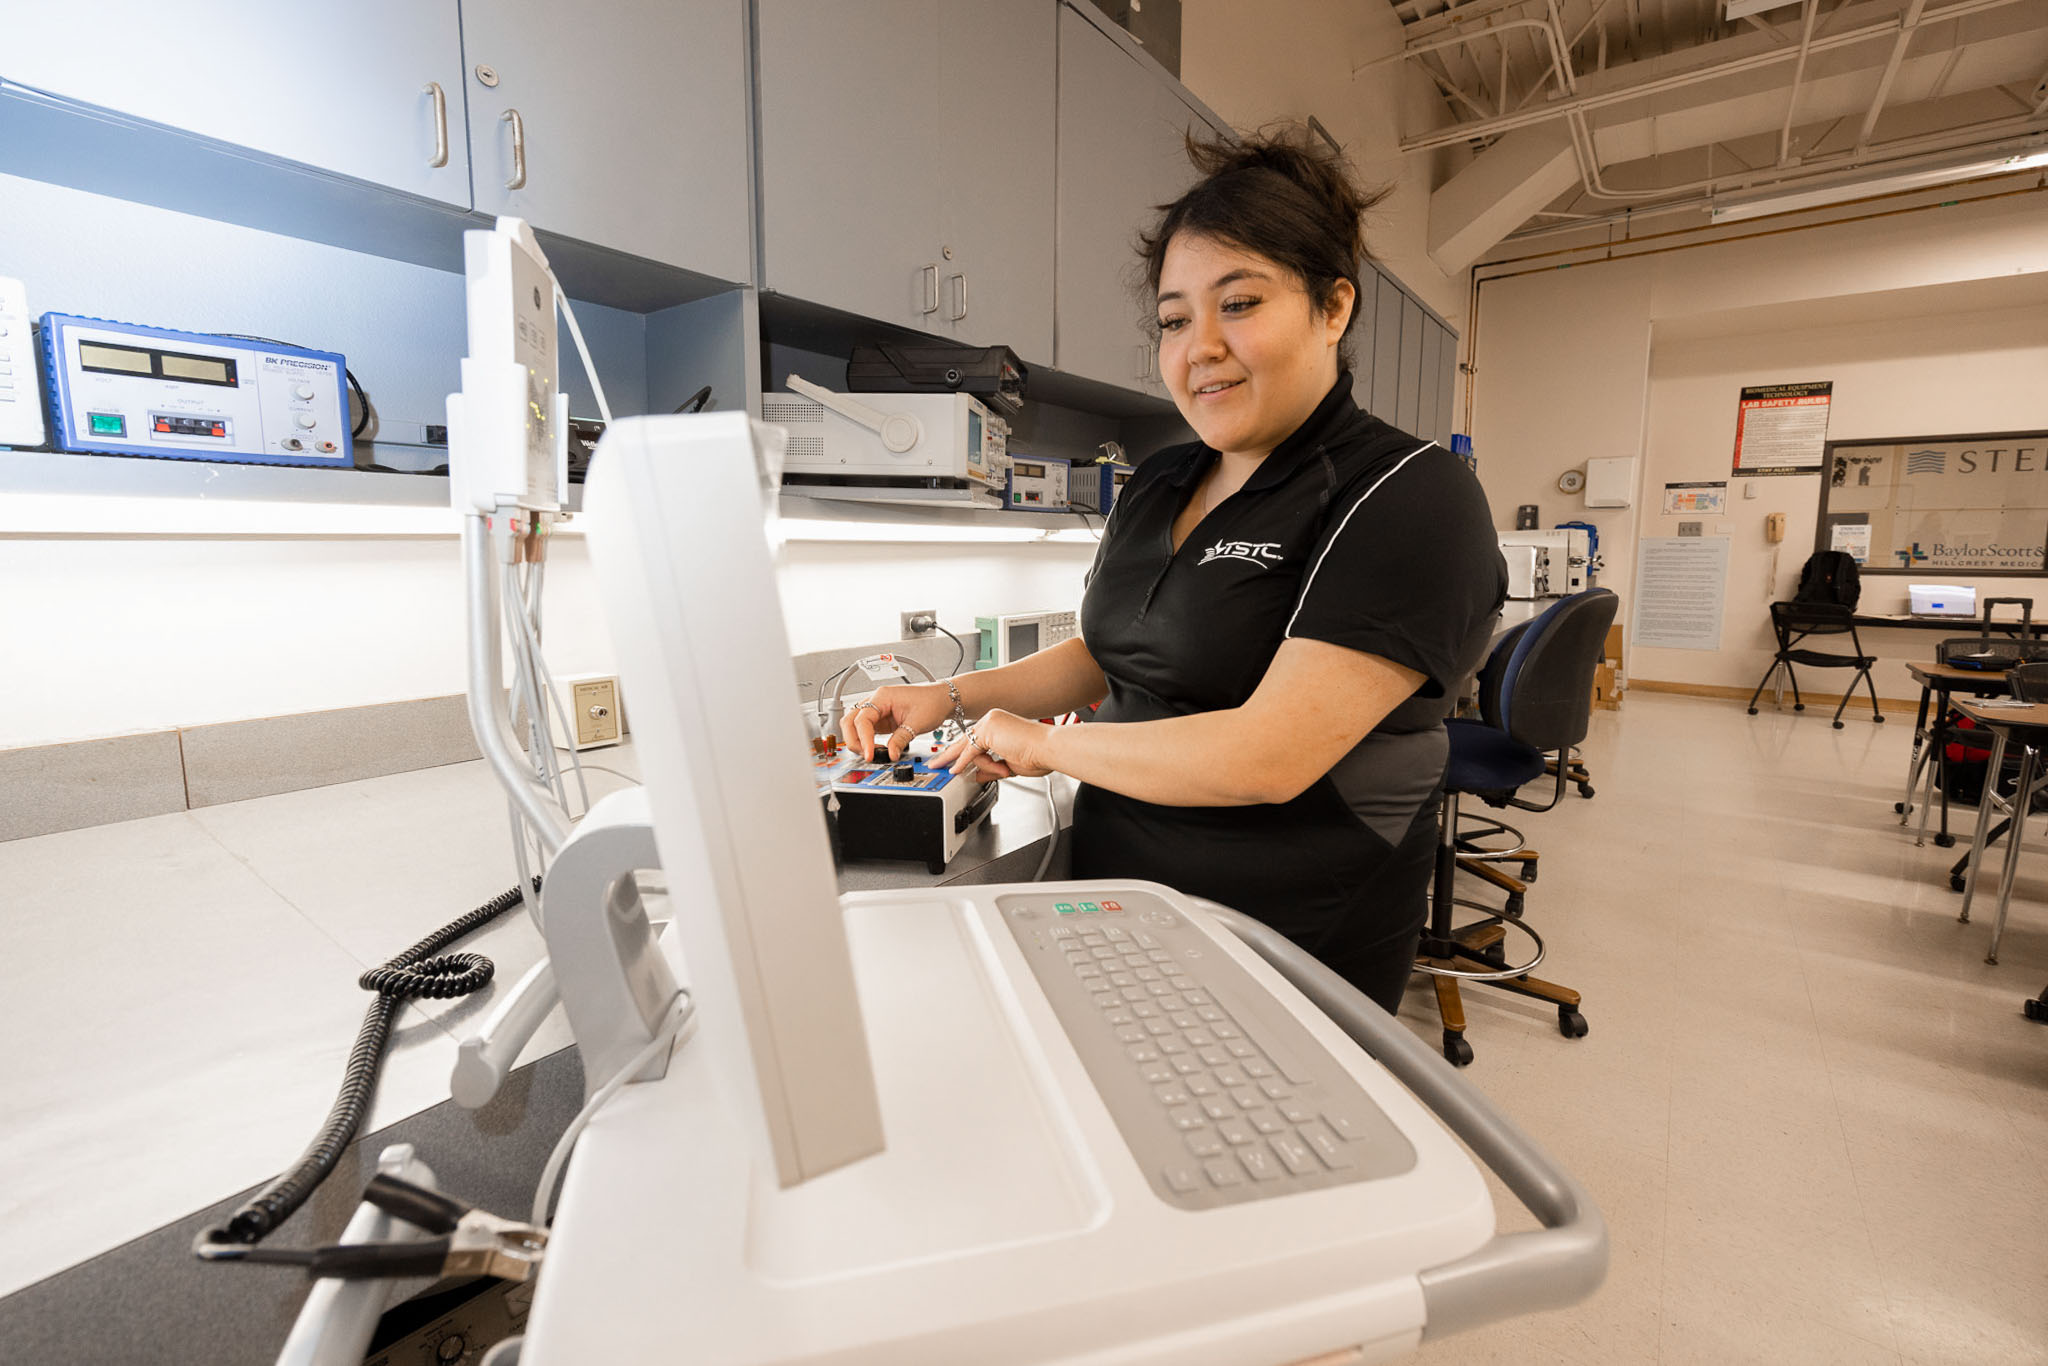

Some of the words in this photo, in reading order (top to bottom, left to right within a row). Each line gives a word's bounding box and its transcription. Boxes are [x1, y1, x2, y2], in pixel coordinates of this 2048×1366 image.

[265, 356, 278, 364] BK
[280, 358, 328, 371] PRECISION
[1746, 386, 1785, 394] BIOMEDICAL
[1787, 383, 1828, 392] EQUIPMENT
[1763, 391, 1808, 399] TECHNOLOGY
[1742, 401, 1760, 409] LAB
[1761, 399, 1795, 408] SAFETY
[1797, 397, 1828, 405] RULES
[1957, 447, 2048, 474] STE
[1223, 541, 1283, 560] TSTC
